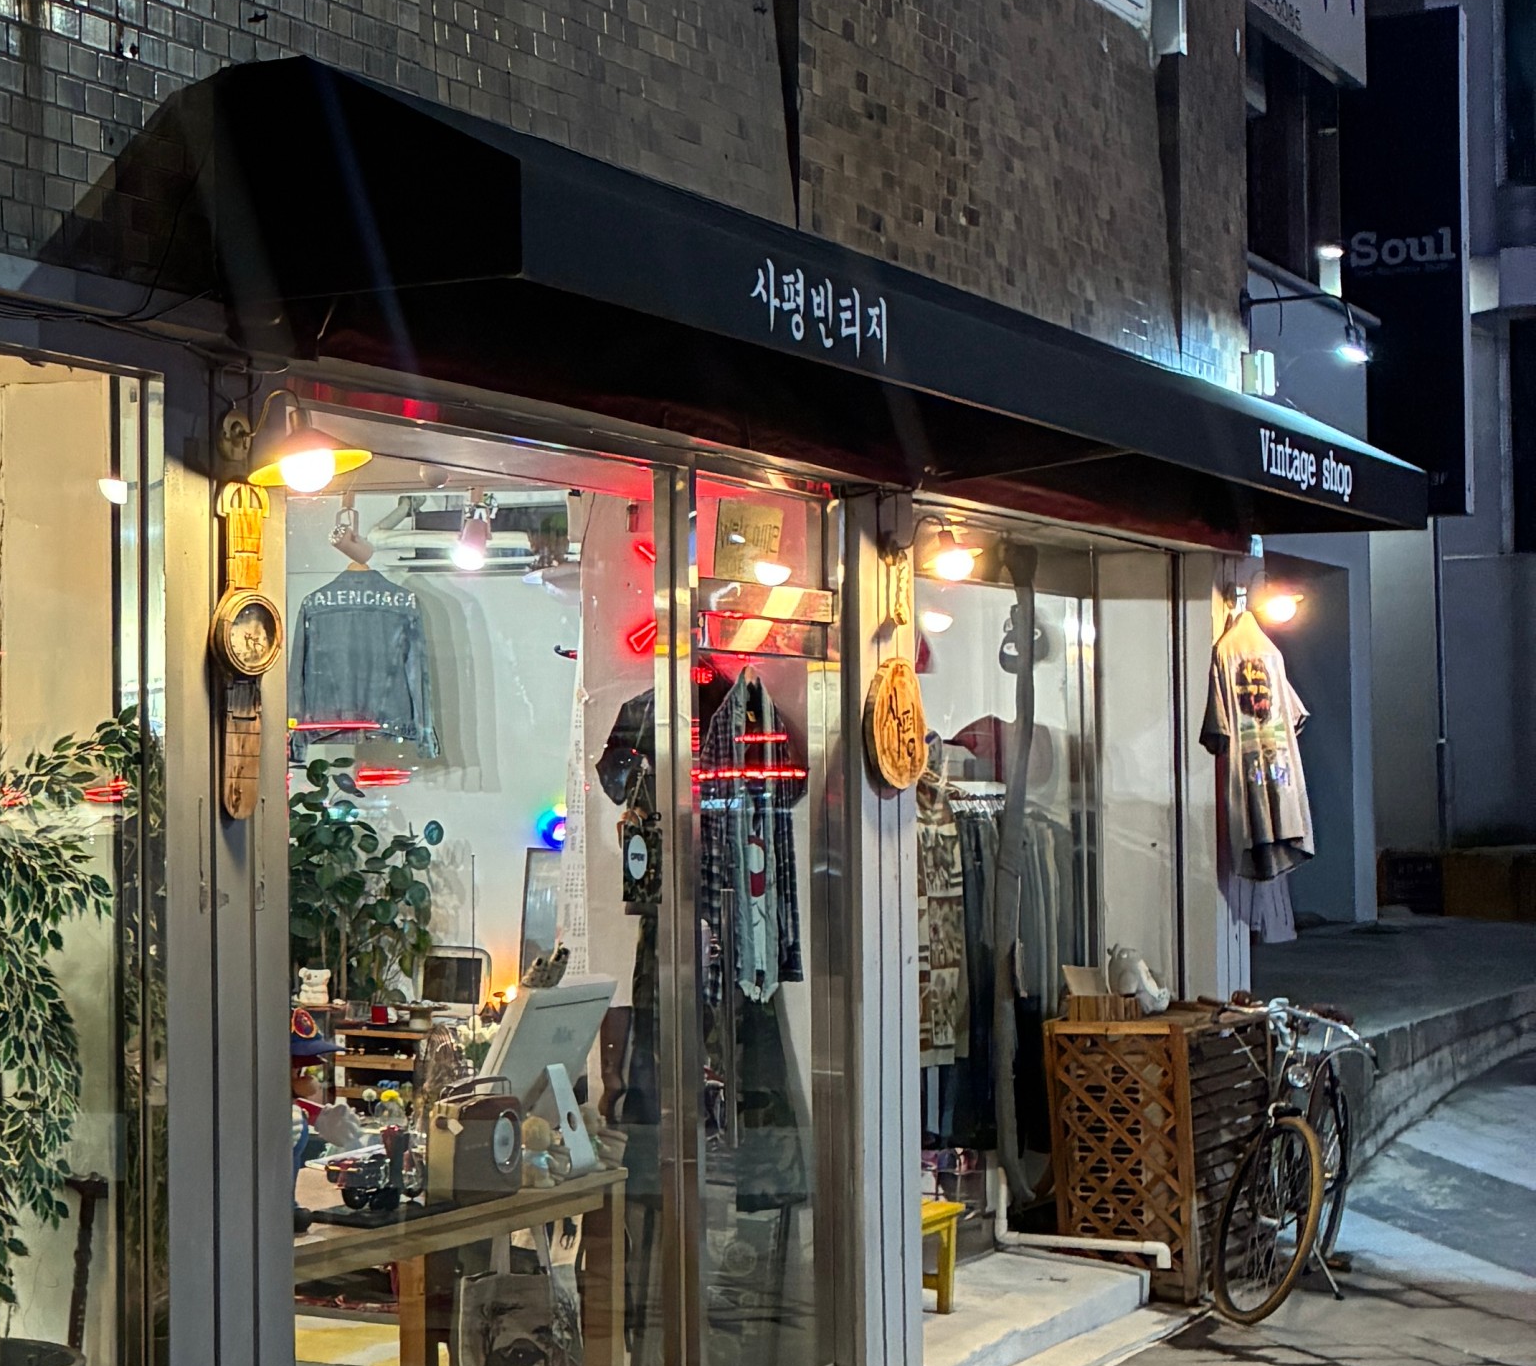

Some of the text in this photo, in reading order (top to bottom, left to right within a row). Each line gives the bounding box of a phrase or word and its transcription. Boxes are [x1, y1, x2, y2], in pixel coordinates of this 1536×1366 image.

[1350, 227, 1456, 268] Soul
[750, 257, 888, 365] 사평빈티지
[1260, 428, 1352, 503] Vintage shop
[303, 590, 417, 610] BALENCIAGA
